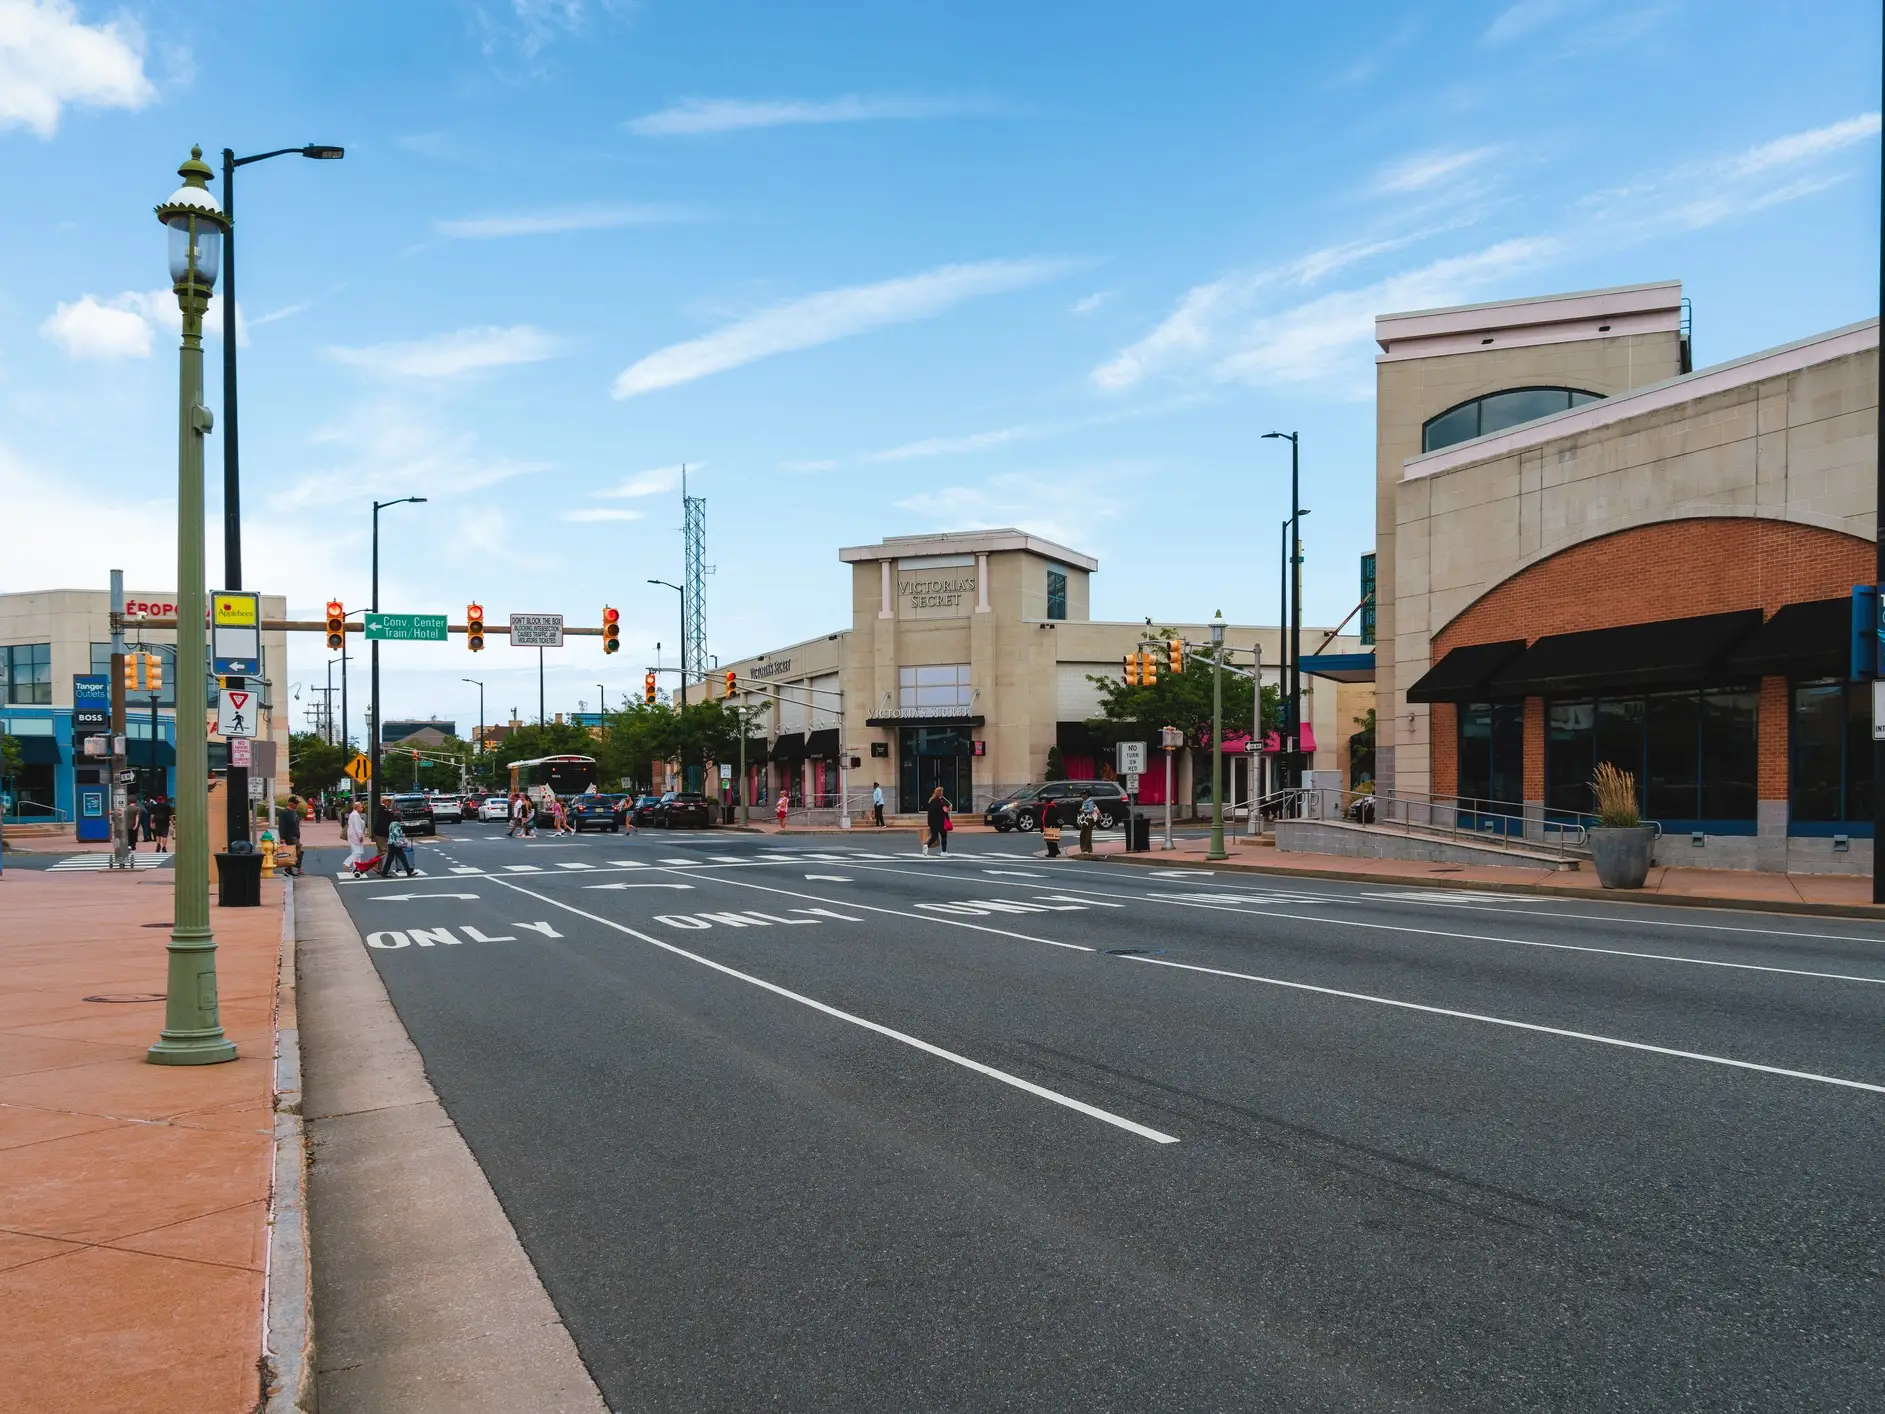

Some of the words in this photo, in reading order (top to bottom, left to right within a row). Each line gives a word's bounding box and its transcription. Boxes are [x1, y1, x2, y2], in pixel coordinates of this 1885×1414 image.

[898, 578, 976, 594] VICTORIA'S
[911, 594, 962, 608] SECRET
[383, 616, 410, 627] Conv.
[413, 617, 445, 628] Center
[526, 617, 541, 625] BLOCK
[542, 617, 551, 625] THE
[552, 617, 561, 625] BOX
[384, 627, 439, 638] Train/Hotel
[75, 683, 104, 691] Tanger
[75, 690, 106, 698] Outlets
[867, 708, 927, 718] VICTORIA'S
[929, 707, 969, 717] SECRET
[1128, 744, 1138, 752] NO
[912, 895, 1126, 916] ONLY
[652, 908, 866, 929] ONLY
[366, 921, 565, 949] ONLY
